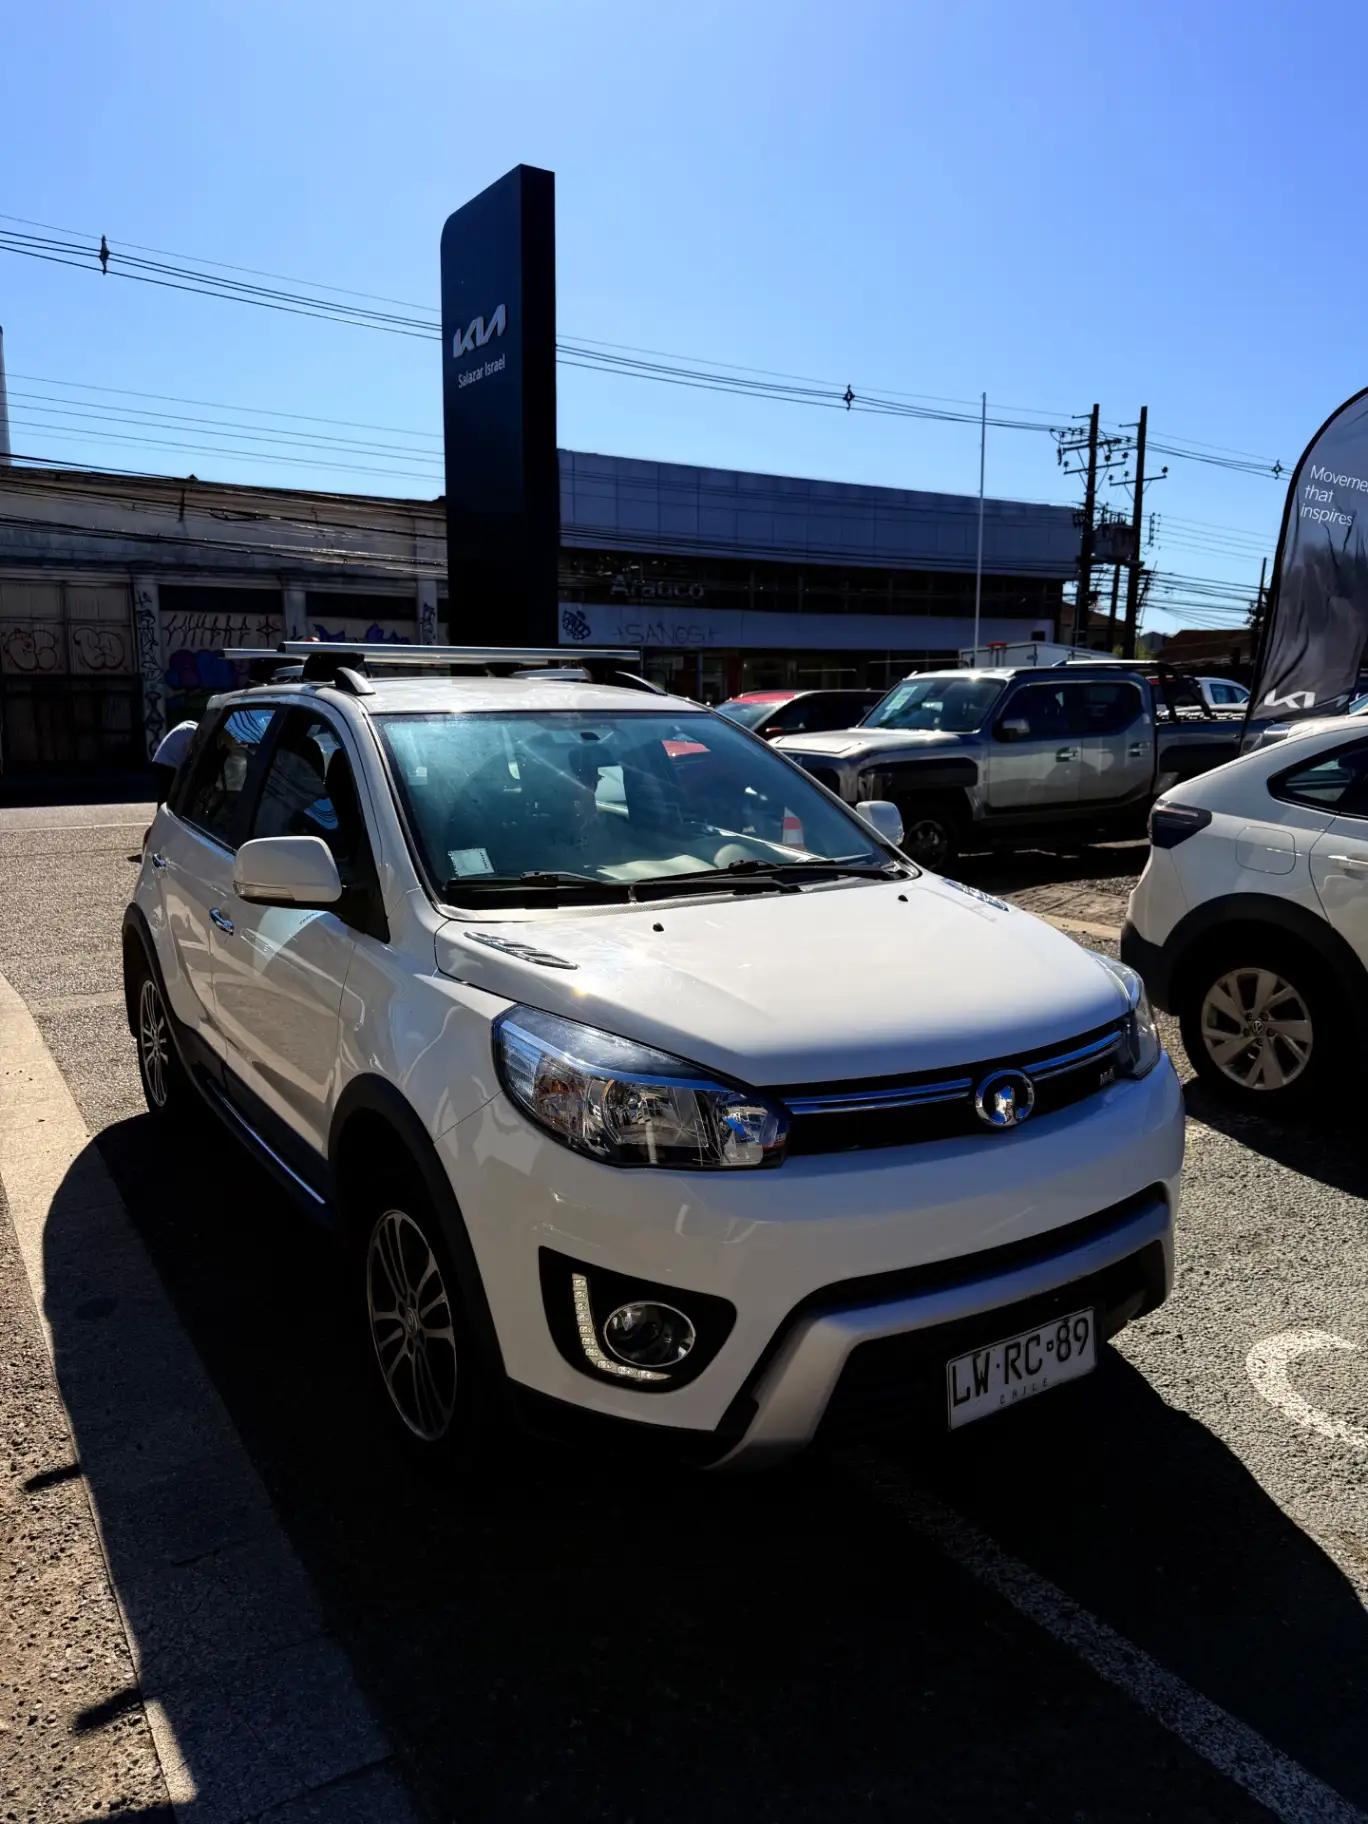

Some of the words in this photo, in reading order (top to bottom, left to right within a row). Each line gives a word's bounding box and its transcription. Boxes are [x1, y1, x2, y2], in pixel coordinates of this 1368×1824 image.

[453, 304, 506, 358] KIA
[458, 366, 484, 389] Salazar
[484, 353, 506, 377] Israel
[1310, 464, 1368, 493] Moveme
[1304, 484, 1334, 503] that
[1300, 503, 1353, 526] inspires
[609, 574, 704, 599] Arauco
